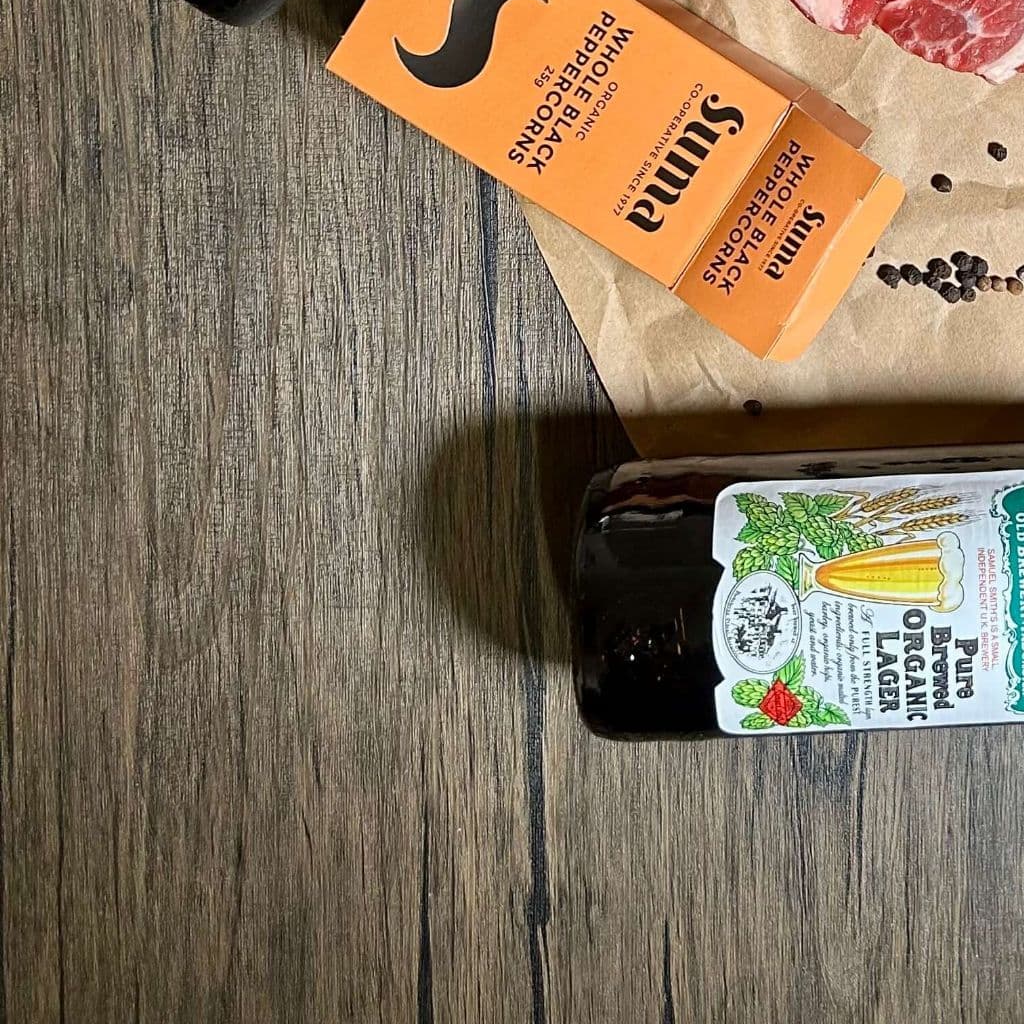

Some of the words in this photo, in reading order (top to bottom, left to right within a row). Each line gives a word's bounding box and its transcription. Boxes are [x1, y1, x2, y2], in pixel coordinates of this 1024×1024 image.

[508, 10, 616, 164] PEPPERCORNS
[534, 65, 555, 88] 25g
[573, 27, 635, 103] WHOLE
[526, 104, 581, 175] BLACK
[575, 81, 618, 141] ORGANIC
[649, 83, 704, 160] CO-OPERATIVE
[624, 94, 744, 232] Suma
[627, 160, 652, 192] SINCE
[761, 154, 815, 226] WHOLE
[612, 193, 630, 217] 1977
[702, 139, 801, 285] PEPPERCORNS
[717, 227, 767, 296] BLACK
[764, 205, 826, 280] Suma
[977, 547, 988, 610] INDEPENDENT
[987, 548, 996, 585] SAMUEL
[989, 587, 998, 623] SMITH'S
[990, 624, 998, 632] IS
[861, 631, 871, 655] FULL
[875, 630, 900, 713] LAGER
[902, 608, 928, 721] ORGANIC
[930, 625, 955, 710] Brewed
[955, 637, 979, 698] Pure
[981, 631, 990, 672] BREWERY
[851, 687, 861, 714] PUREST
[863, 660, 873, 705] STRENGTH
